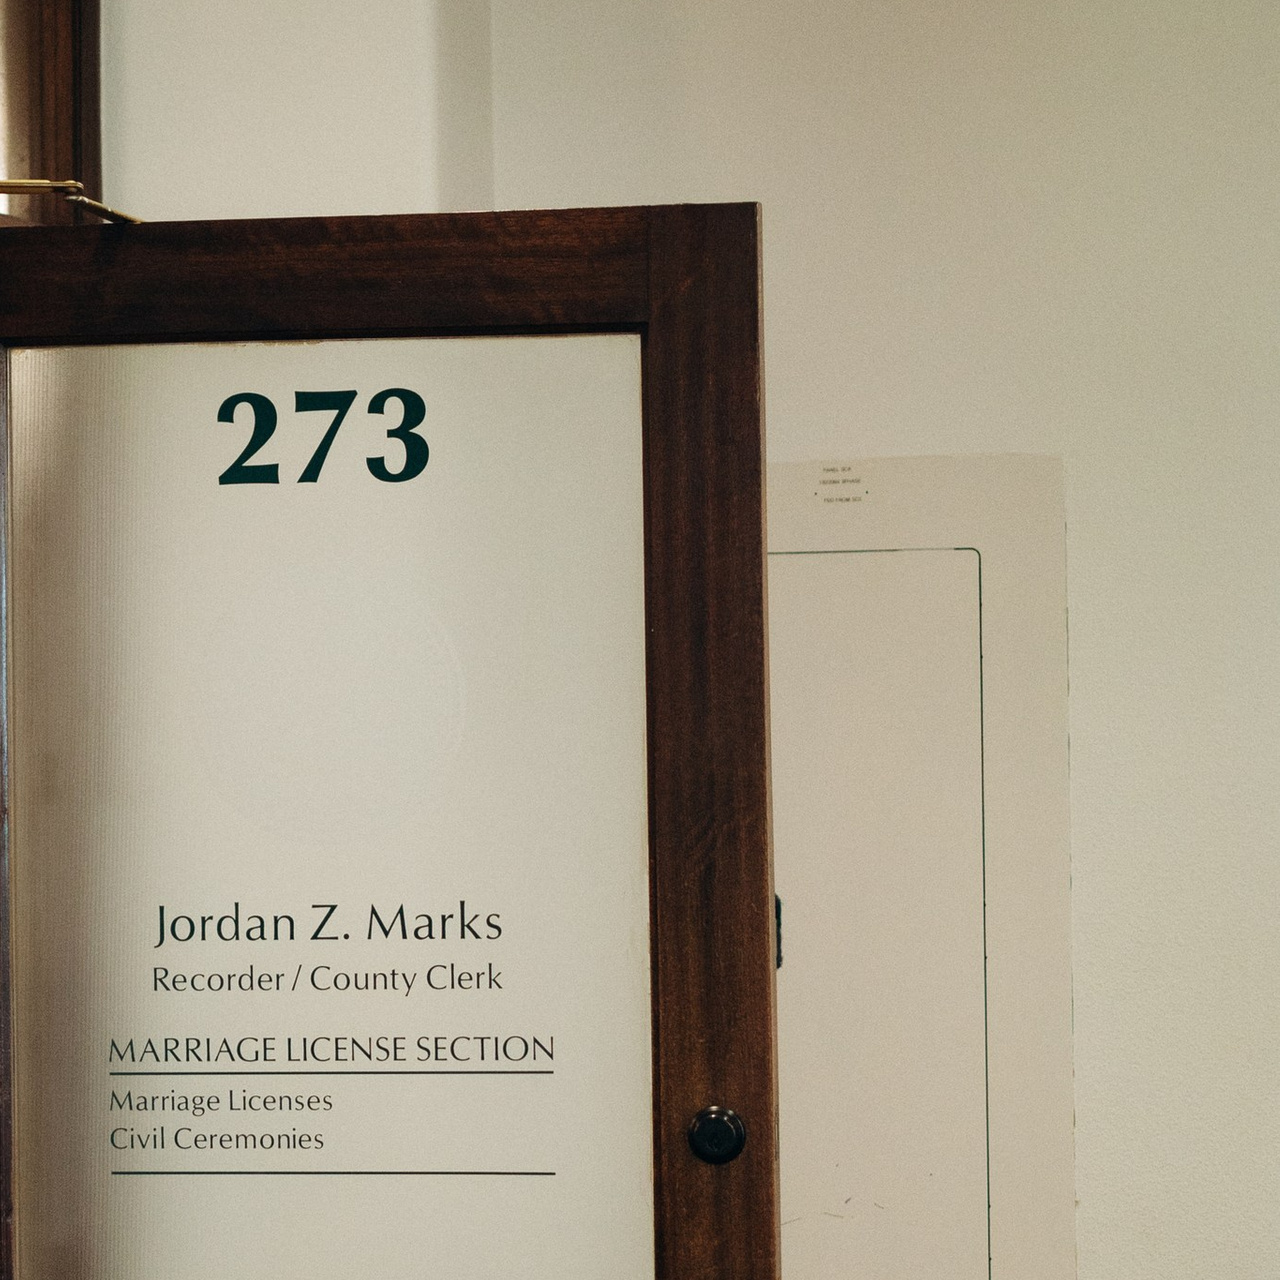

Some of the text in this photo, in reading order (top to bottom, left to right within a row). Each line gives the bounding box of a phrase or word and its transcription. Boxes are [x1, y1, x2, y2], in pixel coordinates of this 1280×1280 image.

[216, 387, 430, 486] 273
[153, 899, 503, 949] Jordan Z. Marks
[153, 964, 285, 992] Recorder
[309, 965, 418, 998] County
[425, 962, 503, 991] Clerk
[108, 1035, 555, 1063] MARRIAGE LICENSE SECTION
[109, 1088, 333, 1117] Marriage Licenses
[109, 1126, 325, 1150] Civil Ceremonies
